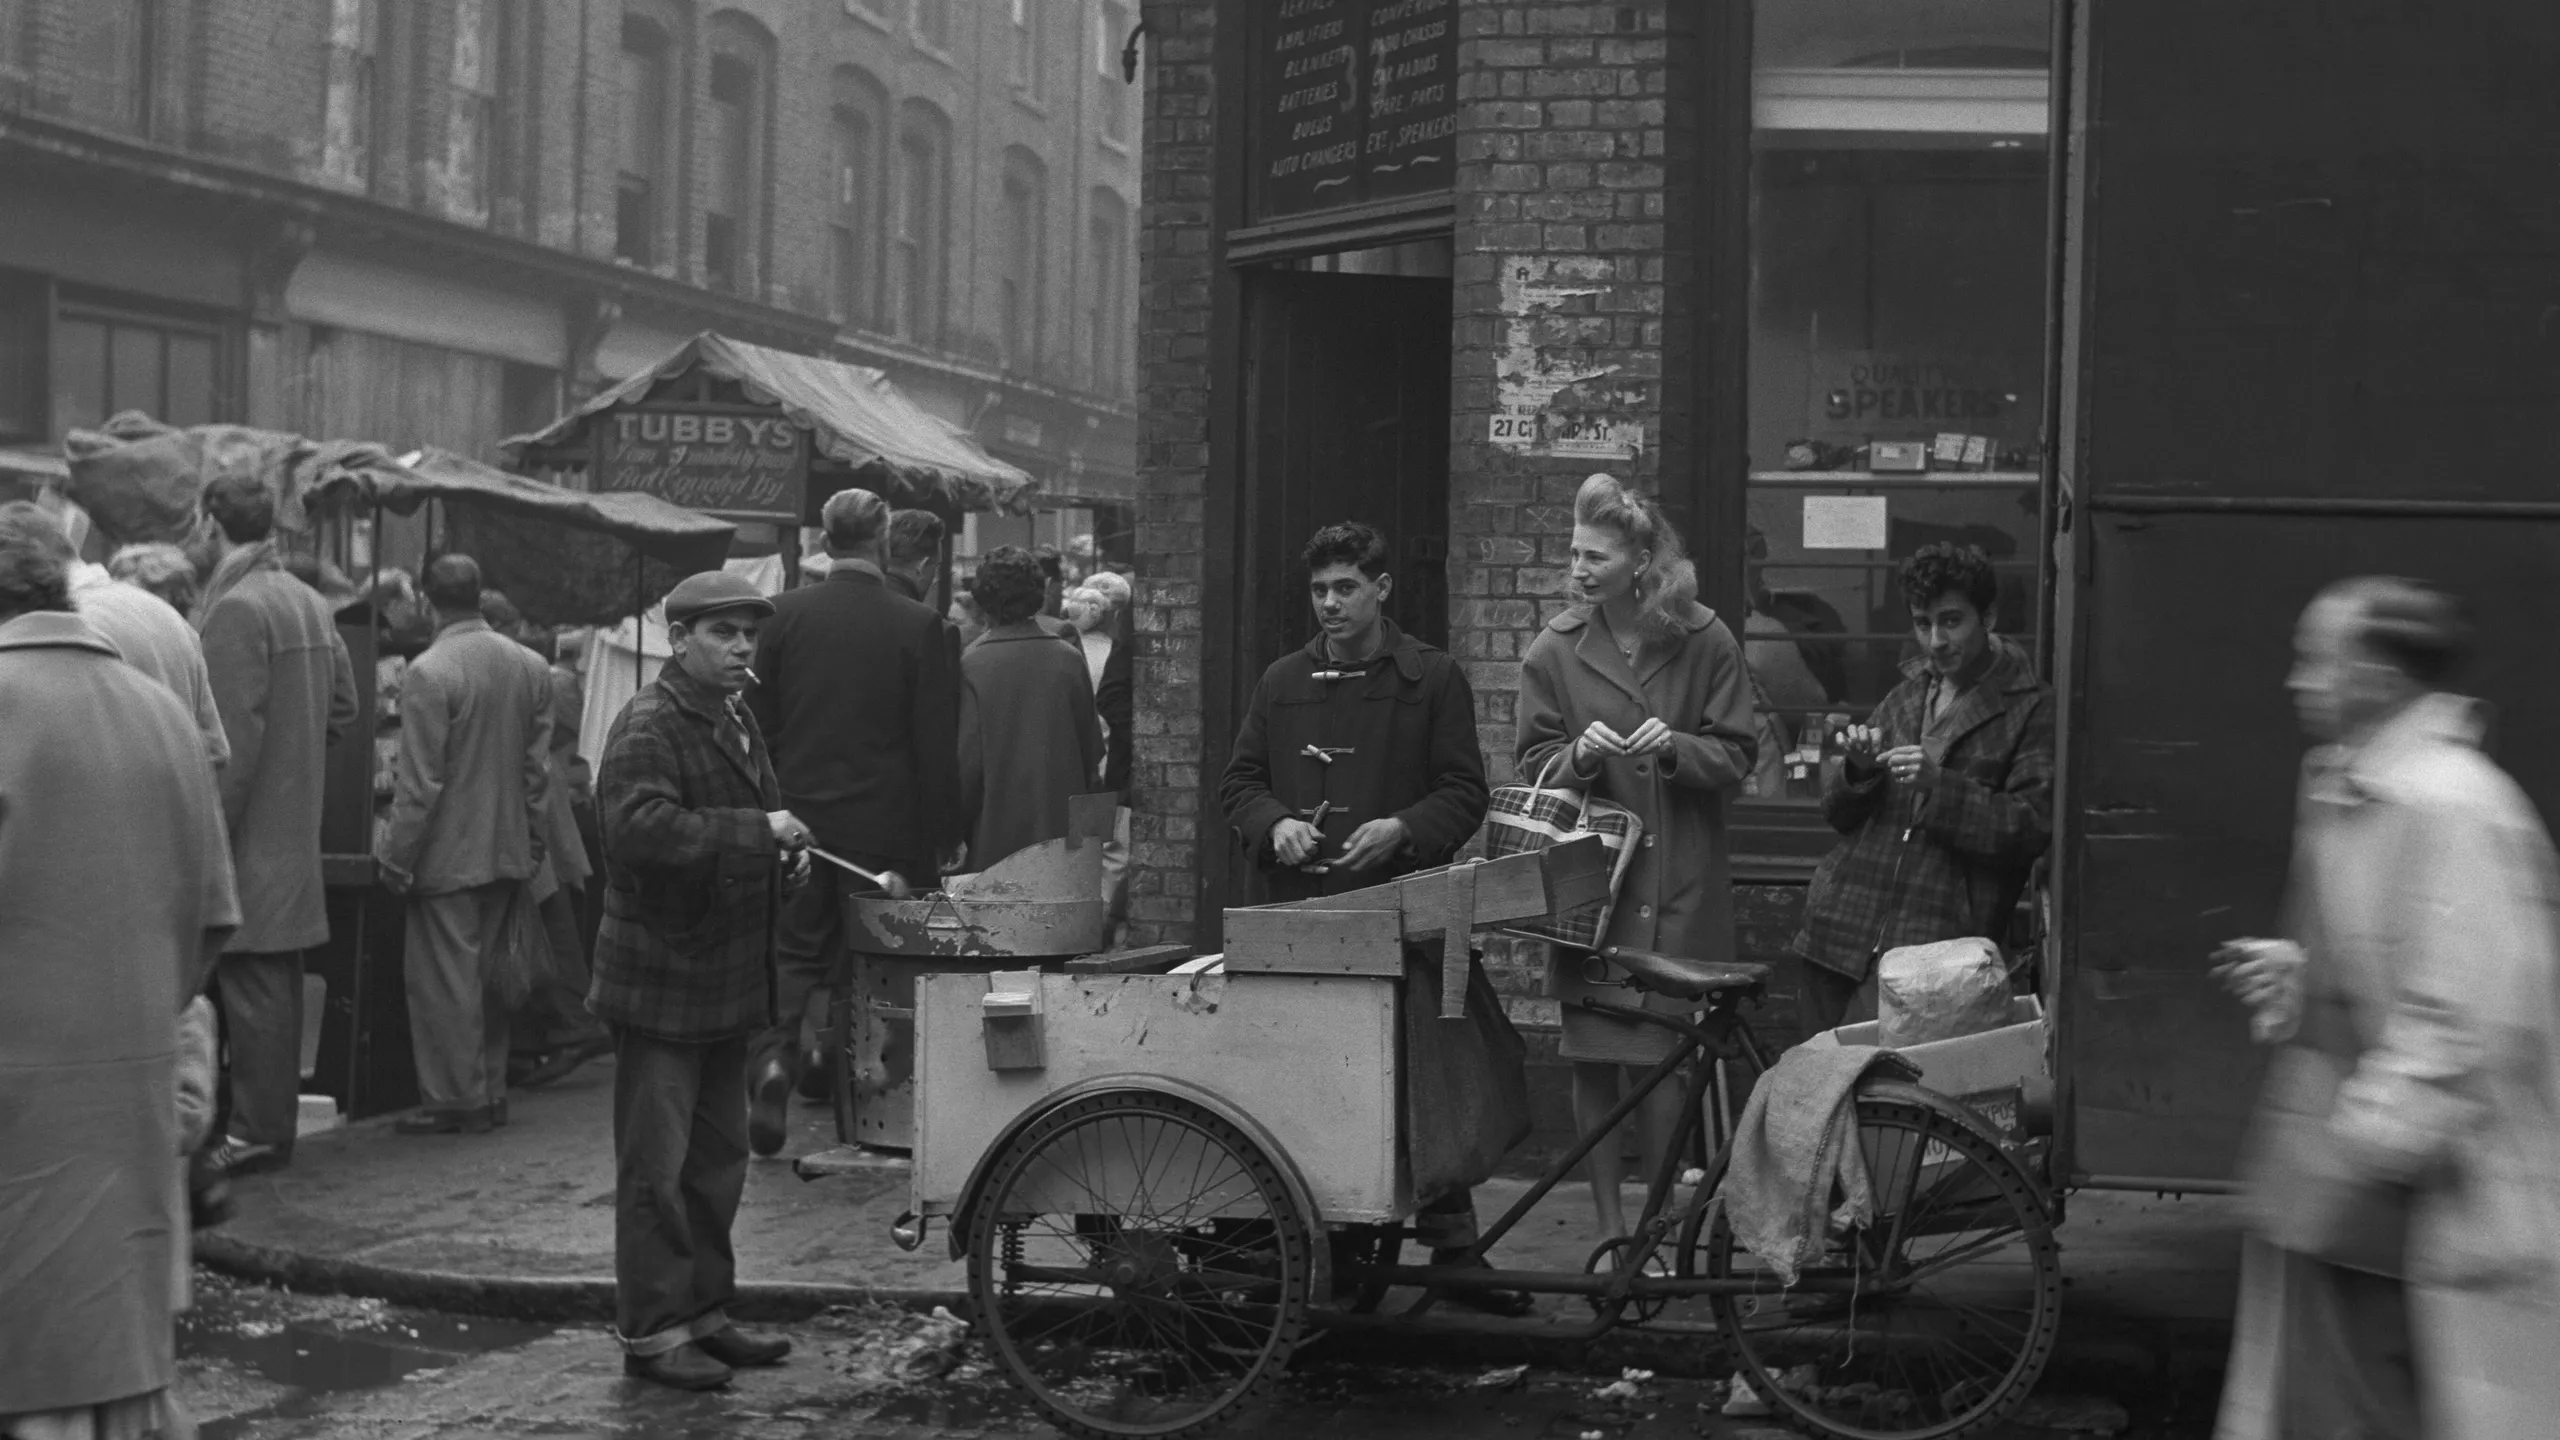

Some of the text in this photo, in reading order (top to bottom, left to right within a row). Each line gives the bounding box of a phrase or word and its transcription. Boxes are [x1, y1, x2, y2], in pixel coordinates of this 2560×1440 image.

[1274, 19, 1344, 53] AMPLIFIERS
[1278, 81, 1338, 113] BATTERIES
[1409, 84, 1446, 108] PARTS
[1396, 113, 1458, 148] SPEAKERS
[1269, 140, 1358, 178] AUTO CHANGERS
[1825, 387, 2001, 420] SPEAKERS
[1493, 419, 1513, 437] 27
